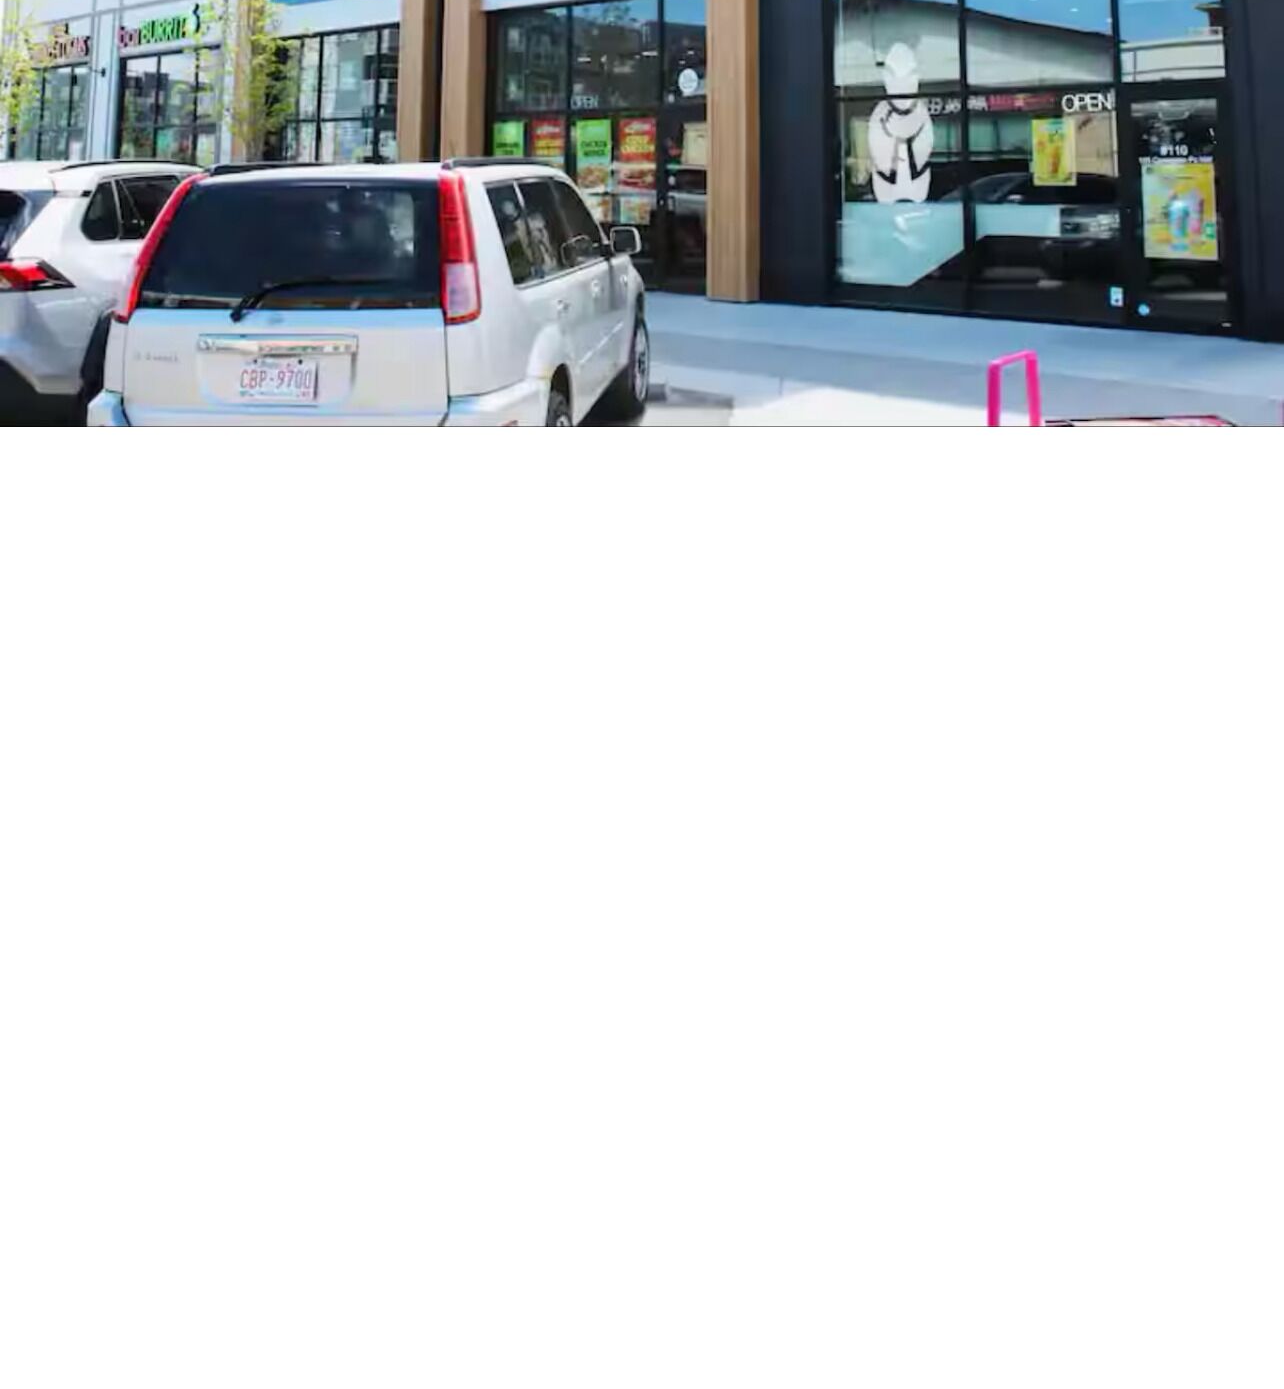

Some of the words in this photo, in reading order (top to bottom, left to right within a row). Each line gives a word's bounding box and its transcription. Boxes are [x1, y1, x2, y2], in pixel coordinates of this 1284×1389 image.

[570, 94, 599, 109] OPEN
[1062, 93, 1114, 112] OPEN
[239, 368, 313, 390] CBP-9700
